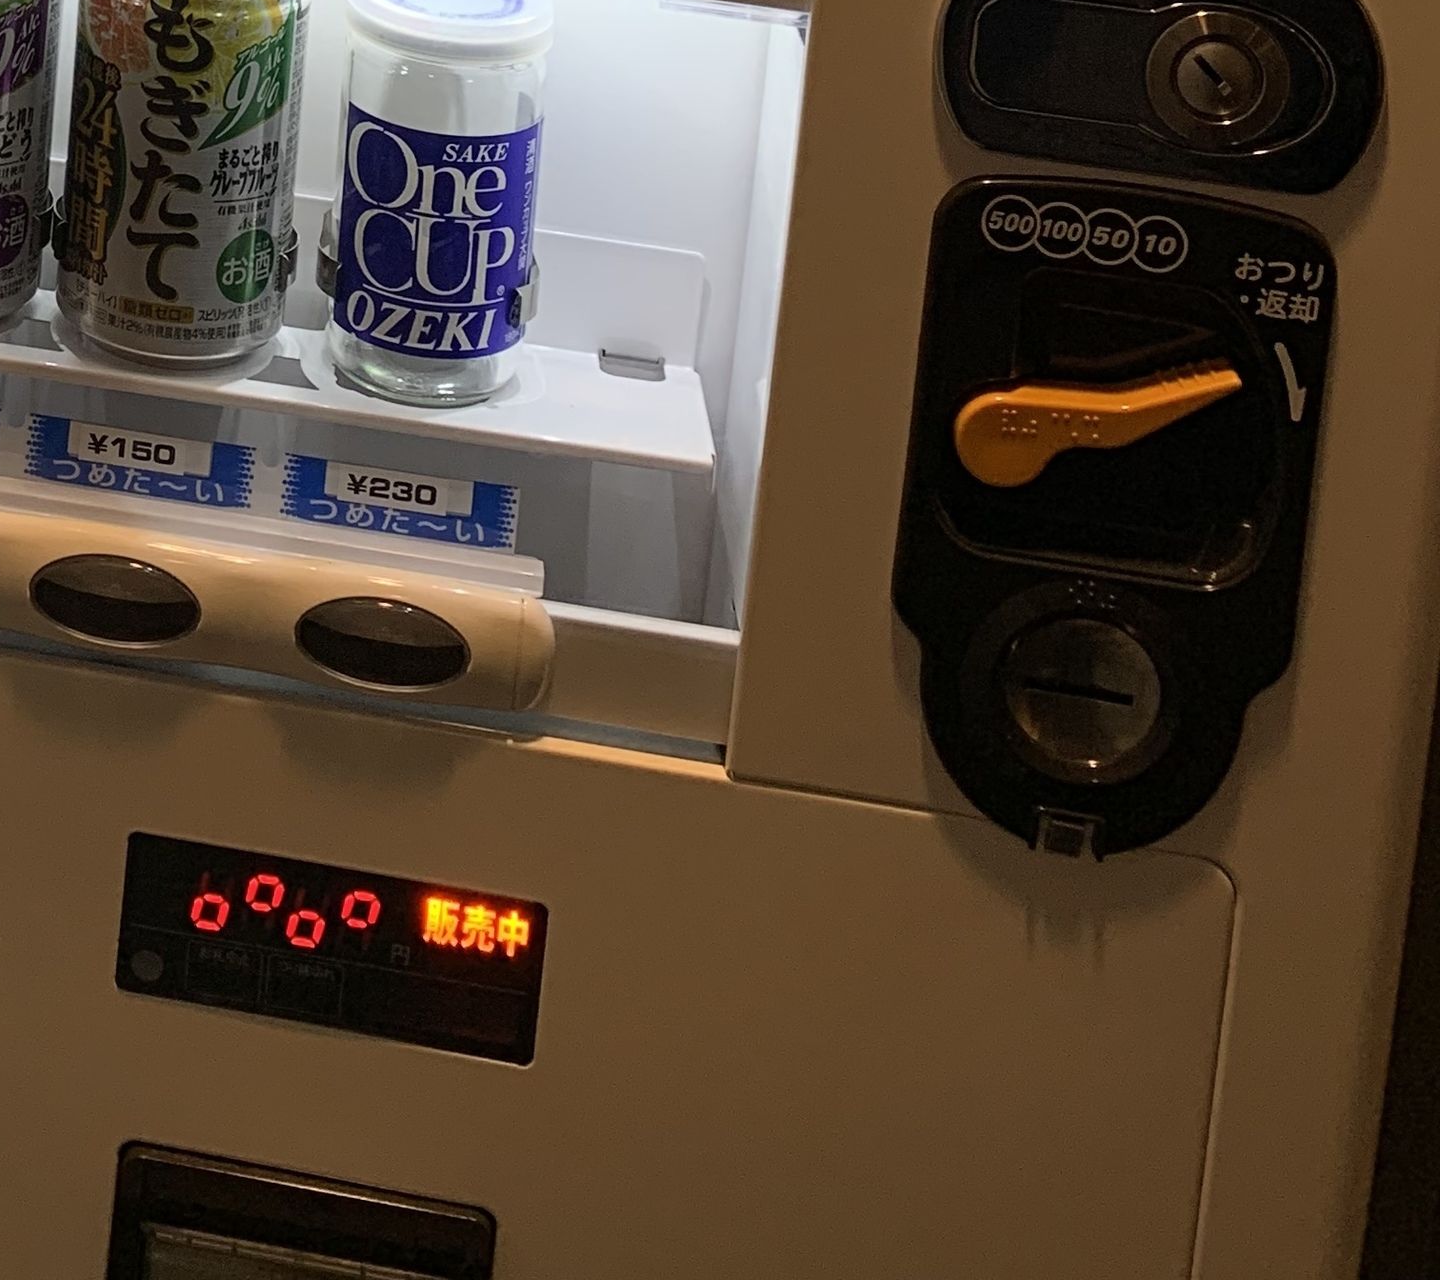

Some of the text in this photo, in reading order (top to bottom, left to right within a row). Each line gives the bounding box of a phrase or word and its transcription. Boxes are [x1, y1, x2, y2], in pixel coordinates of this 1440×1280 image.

[347, 121, 508, 218] One
[442, 141, 510, 162] SAKE
[987, 211, 1177, 256] 500 100 50 10
[221, 247, 273, 286] お酒
[352, 208, 516, 307] CUP
[1234, 252, 1324, 291] おつり
[345, 288, 498, 352] OZEKI
[86, 431, 177, 467] ¥150
[346, 472, 438, 507] ¥230
[422, 895, 530, 958] 販売中
